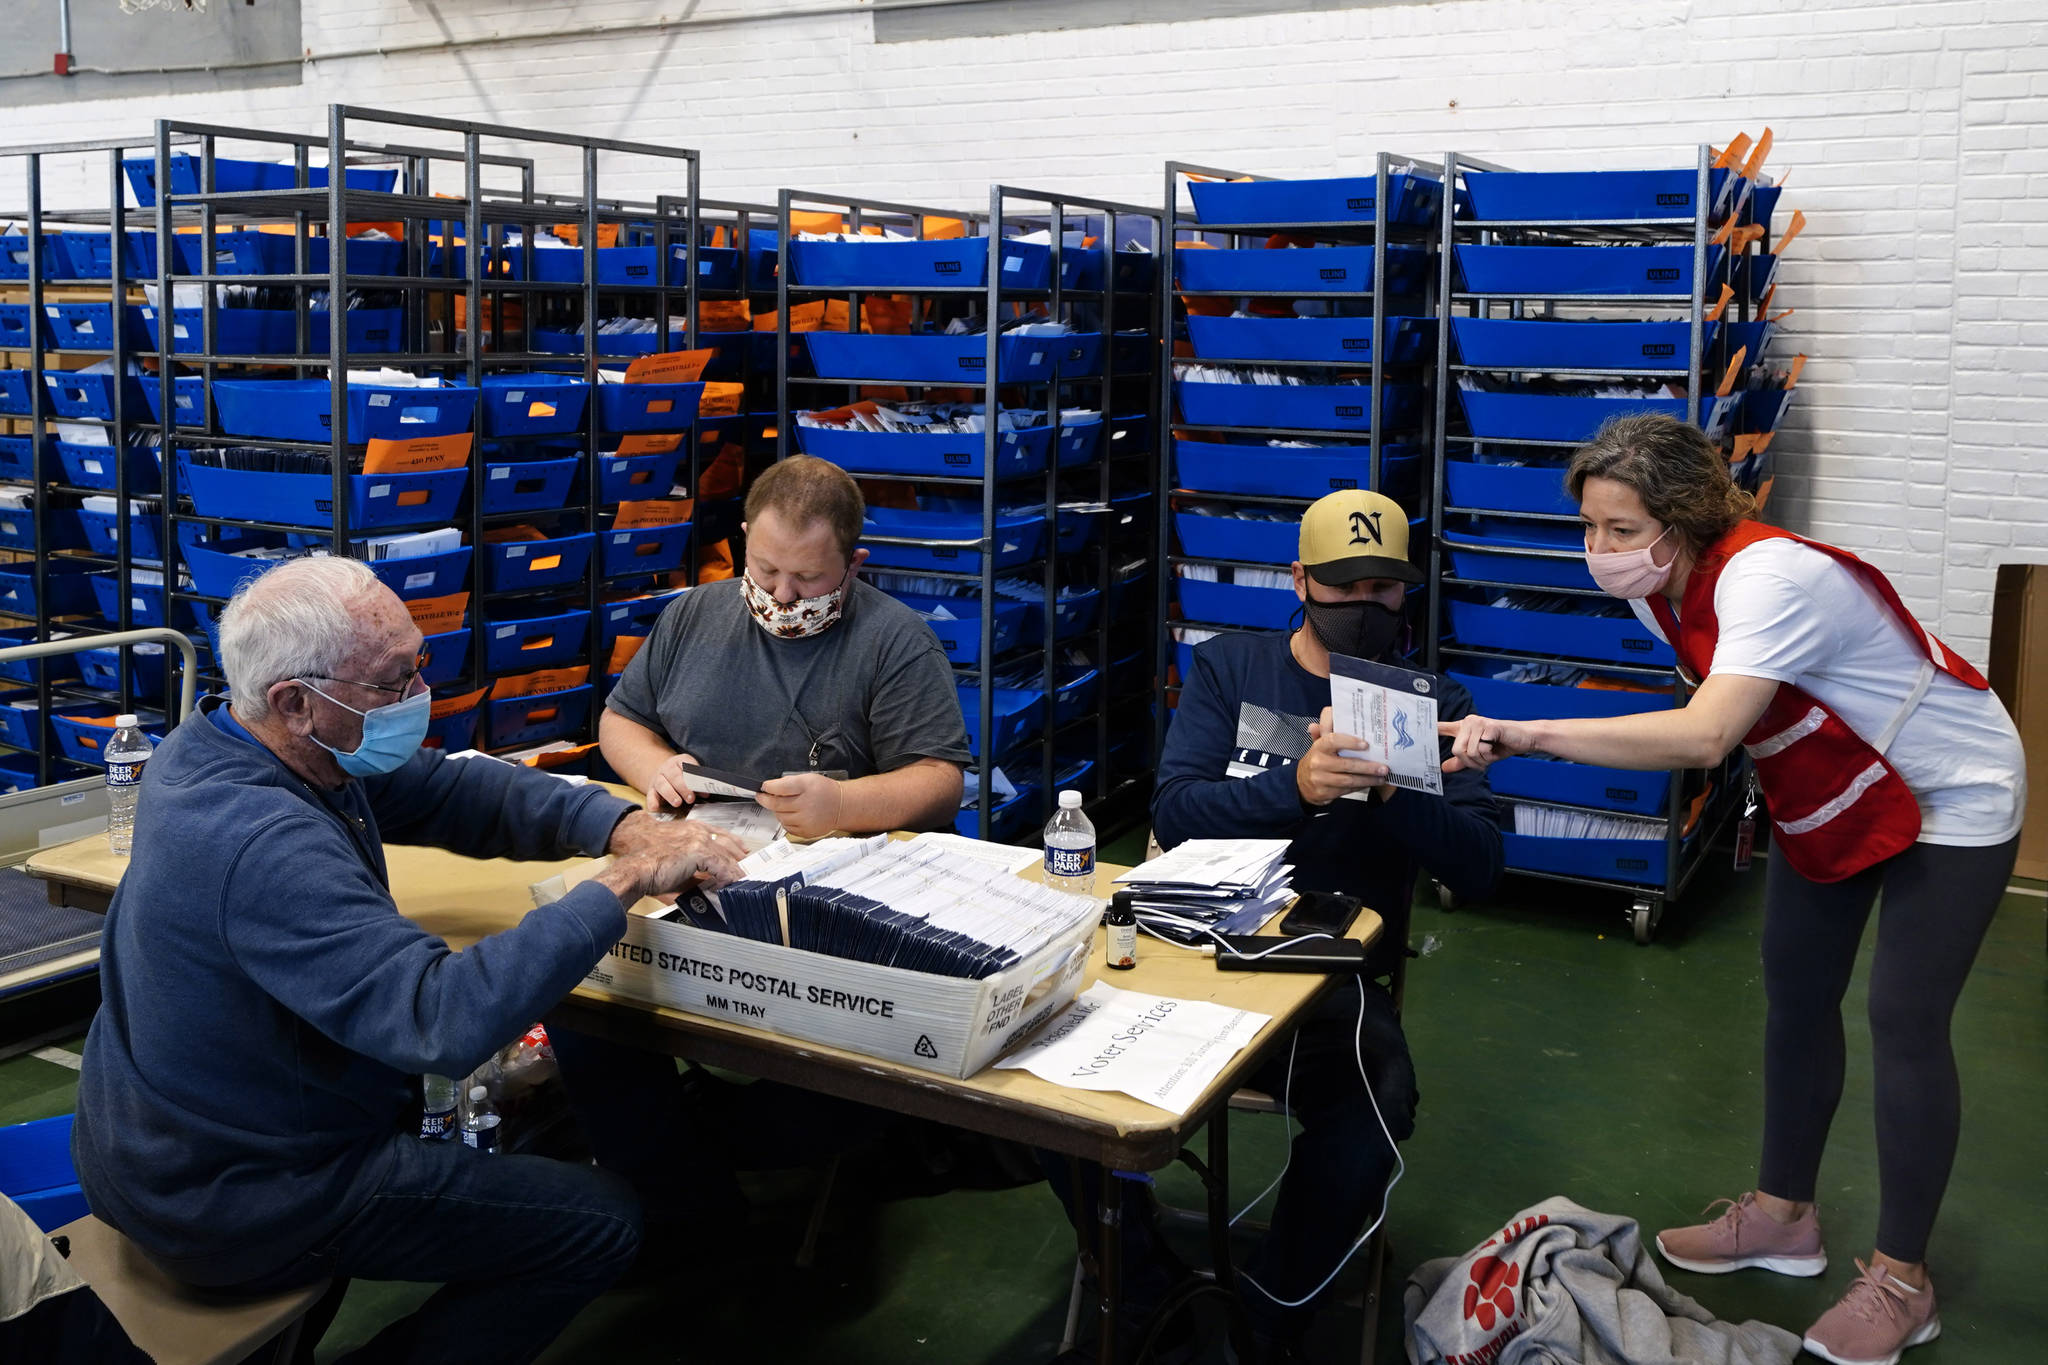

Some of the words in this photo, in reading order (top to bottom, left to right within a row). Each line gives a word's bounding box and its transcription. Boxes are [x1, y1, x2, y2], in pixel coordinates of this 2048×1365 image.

[1347, 199, 1374, 208] ULINE
[1657, 194, 1688, 204] ULINE
[937, 262, 960, 271] ULINE
[1321, 270, 1345, 278] ULINE
[1646, 270, 1679, 279] ULINE
[1343, 340, 1369, 348] ULINE
[1643, 345, 1673, 354] ULINE
[960, 359, 985, 367] ULINE
[946, 455, 970, 463] ULINE
[1348, 511, 1383, 545] N
[1622, 640, 1652, 649] ULINE
[109, 765, 131, 773] DEER
[110, 773, 133, 781] PARK
[1054, 852, 1080, 861] DEER
[1054, 861, 1081, 871] PARK
[609, 942, 653, 964] NITED
[658, 952, 723, 982] STATES
[729, 968, 801, 1000] POSTAL
[806, 985, 895, 1018] SERVICE
[993, 984, 1024, 1008] LABEL
[706, 995, 728, 1011] MM
[732, 1001, 766, 1018] TRAY
[986, 997, 1022, 1022] OTHER
[1071, 1043, 1128, 1077] Voter
[1112, 1000, 1178, 1044] Services
[921, 1043, 928, 1053] 2
